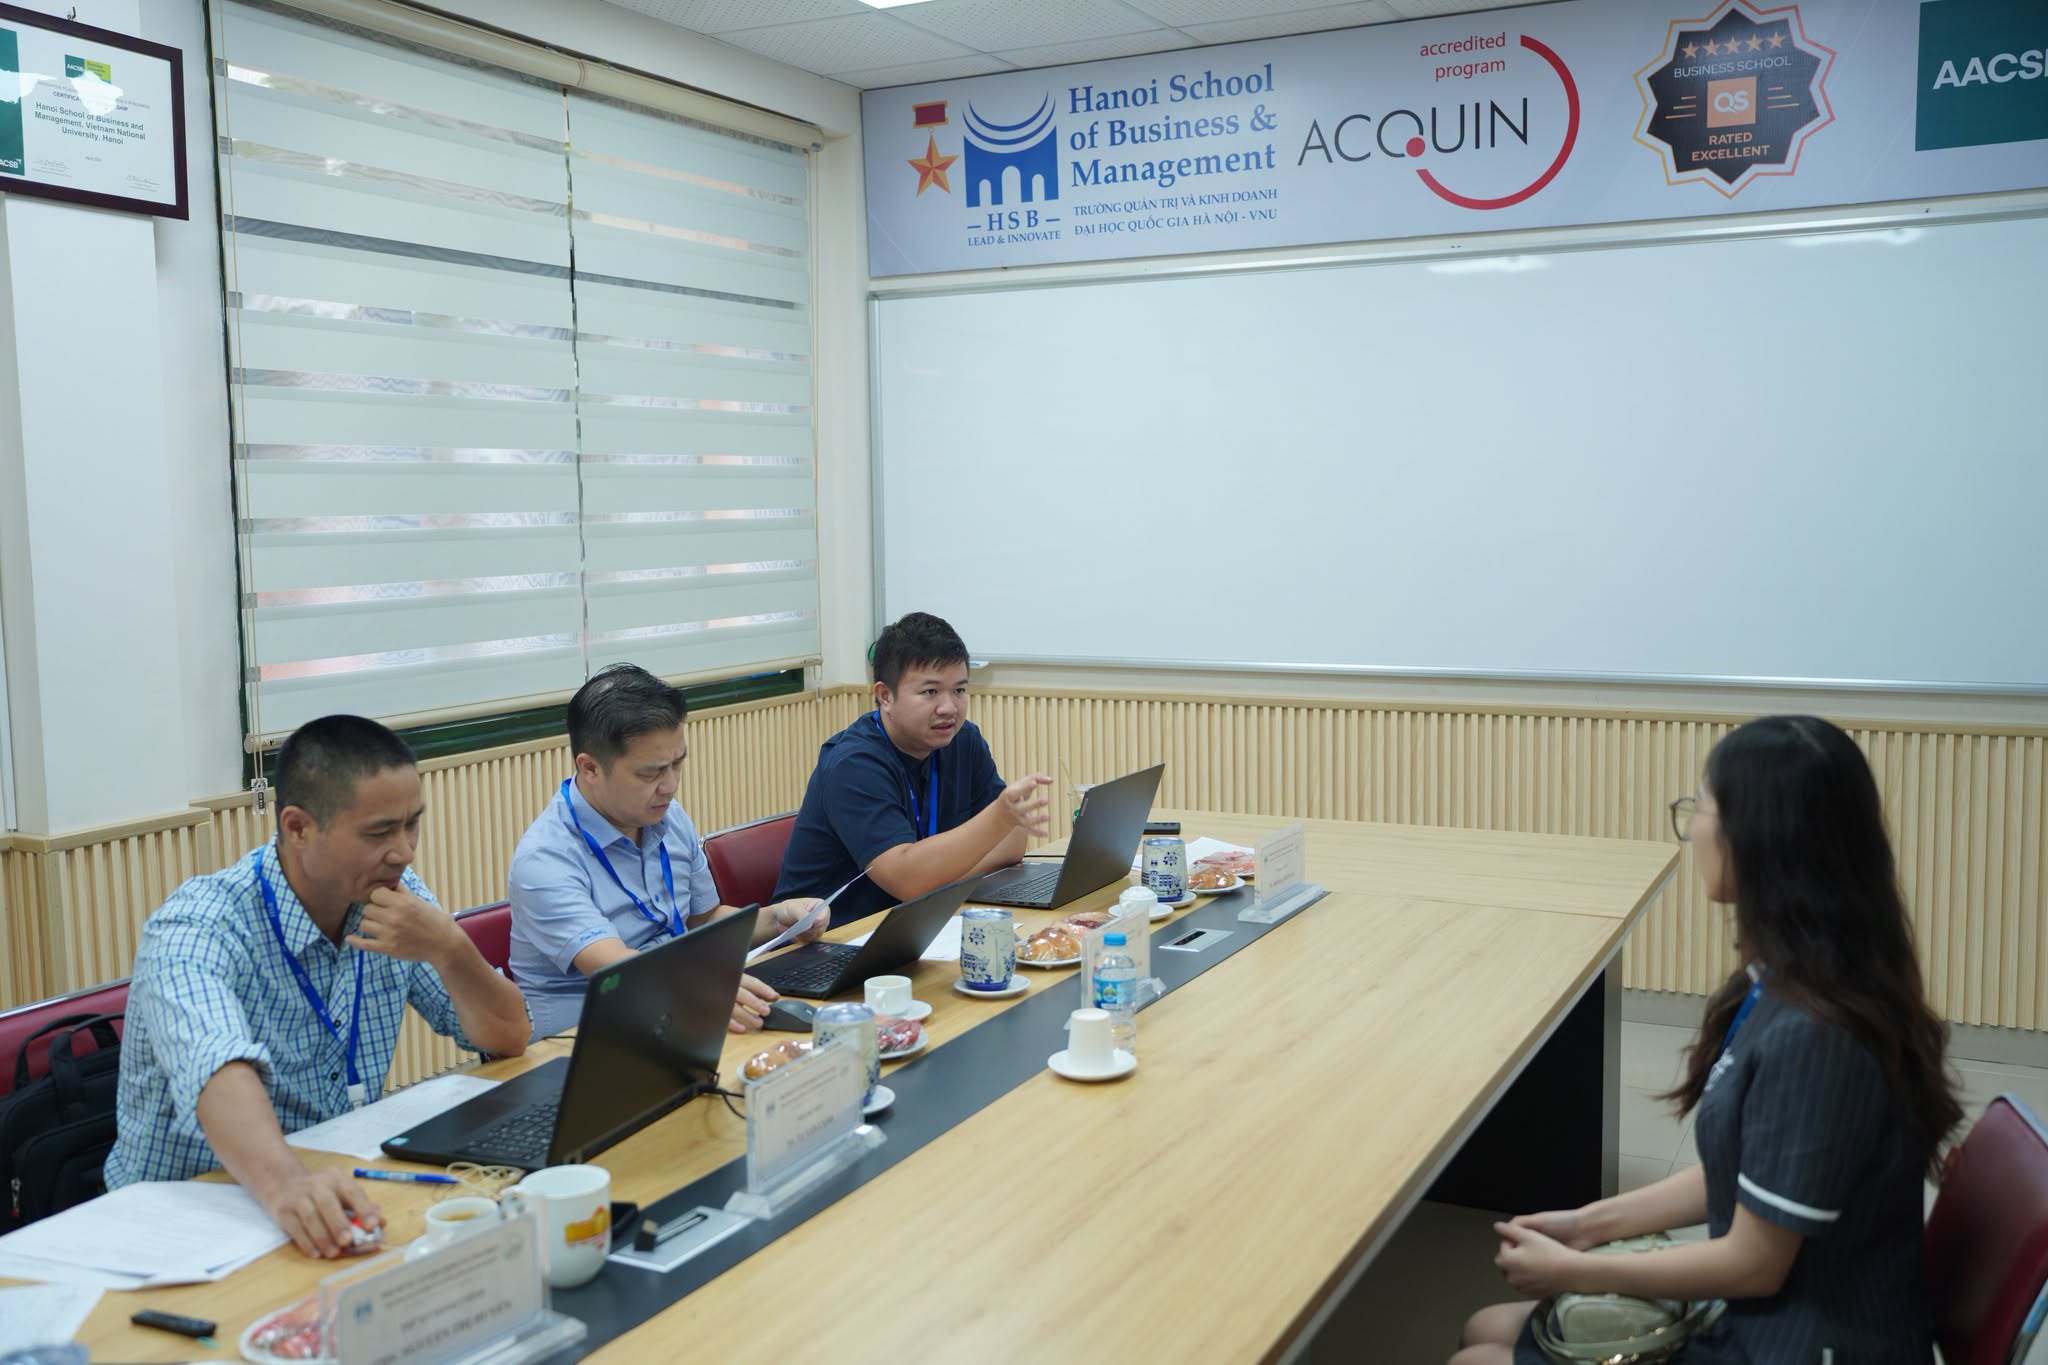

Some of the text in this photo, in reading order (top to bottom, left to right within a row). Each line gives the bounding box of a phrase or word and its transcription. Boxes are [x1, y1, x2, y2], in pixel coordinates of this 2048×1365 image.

[1420, 32, 1506, 57] accredited
[1435, 59, 1506, 82] program
[1674, 56, 1792, 78] BUSINESS SCHOOL
[1932, 48, 2048, 90] AACS
[1068, 63, 1274, 115] Hanoi School
[1714, 90, 1749, 113] QS
[36, 102, 57, 112] Hanoi
[59, 107, 85, 119] School
[96, 115, 129, 128] Business
[85, 122, 115, 133] Vietnam
[117, 128, 146, 140] National
[1070, 104, 1278, 151] of Business &
[1297, 97, 1528, 166] ACQUIN
[1709, 132, 1753, 145] RATED
[102, 134, 124, 145] Hanoi
[1691, 145, 1770, 161] EXCELLENT
[1071, 144, 1276, 188] Management
[1160, 197, 1179, 211] TRỊ
[1181, 194, 1197, 207] VÀ
[1199, 193, 1230, 206] KINH
[1232, 189, 1278, 202] DOANH
[1074, 224, 1096, 237] ĐẠI
[1099, 221, 1125, 234] HỌC
[1128, 216, 1165, 233] QUỐC
[1167, 217, 1189, 229] GIA
[1193, 213, 1211, 226] HÀ
[1249, 209, 1278, 221] VNU
[968, 230, 1061, 247] LEAD & INNOVATE
